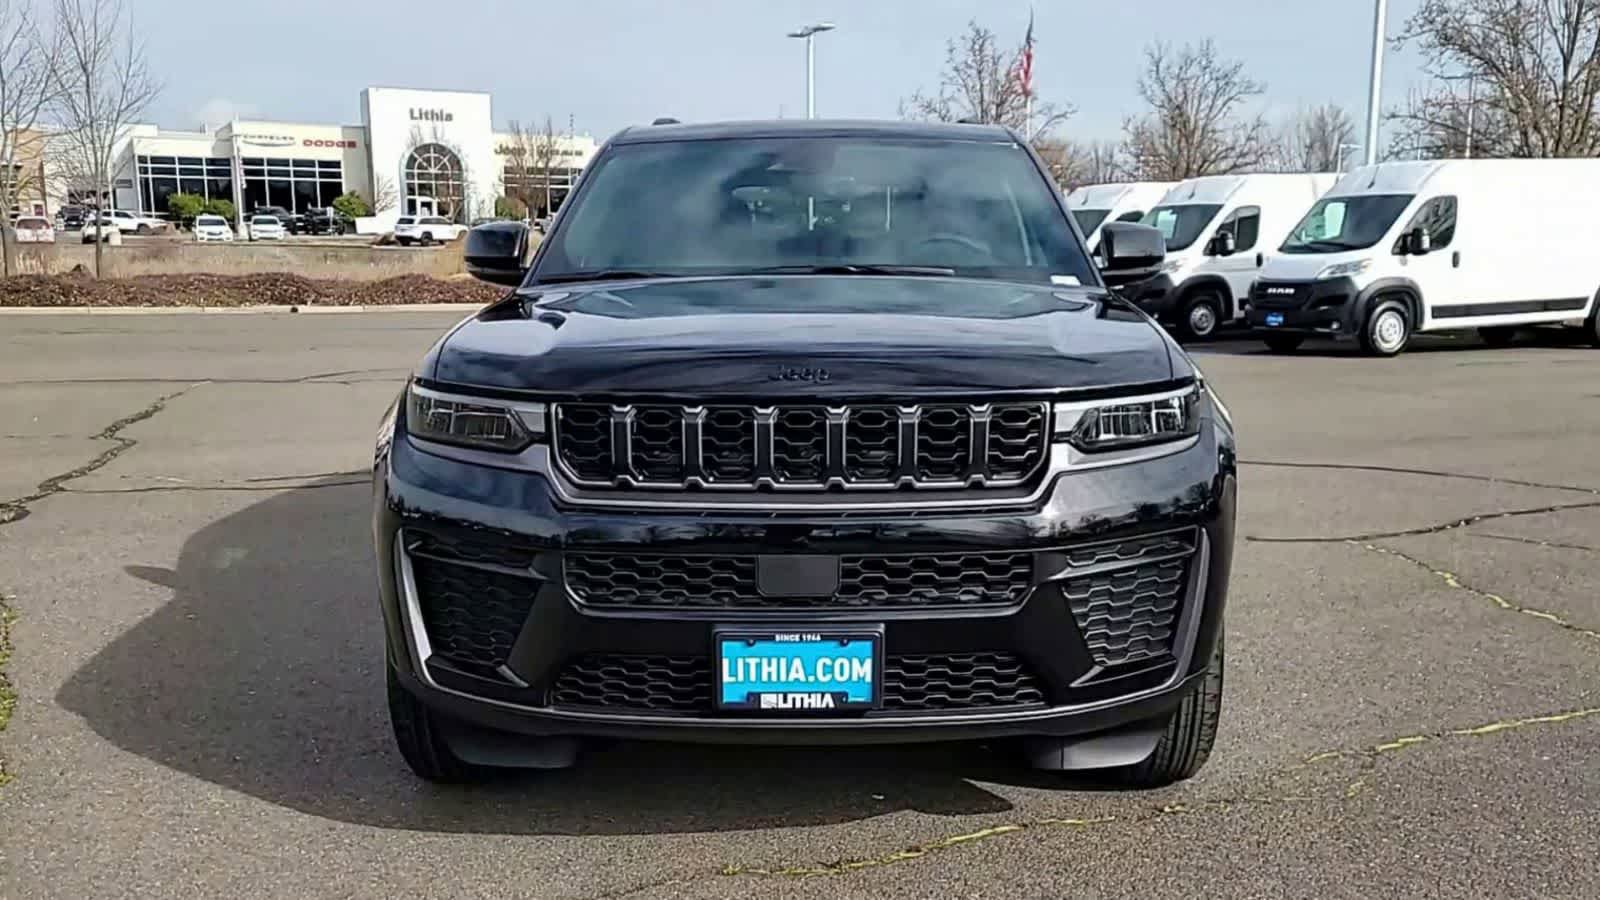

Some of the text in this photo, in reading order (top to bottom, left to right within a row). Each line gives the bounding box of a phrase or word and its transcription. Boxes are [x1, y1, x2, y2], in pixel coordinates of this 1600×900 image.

[409, 107, 453, 122] Lithia
[303, 139, 357, 148] DODGE
[768, 365, 832, 385] Jeep
[775, 633, 800, 642] SINCE
[722, 657, 873, 683] LITHIA.COM
[778, 693, 835, 709] LITHIA
